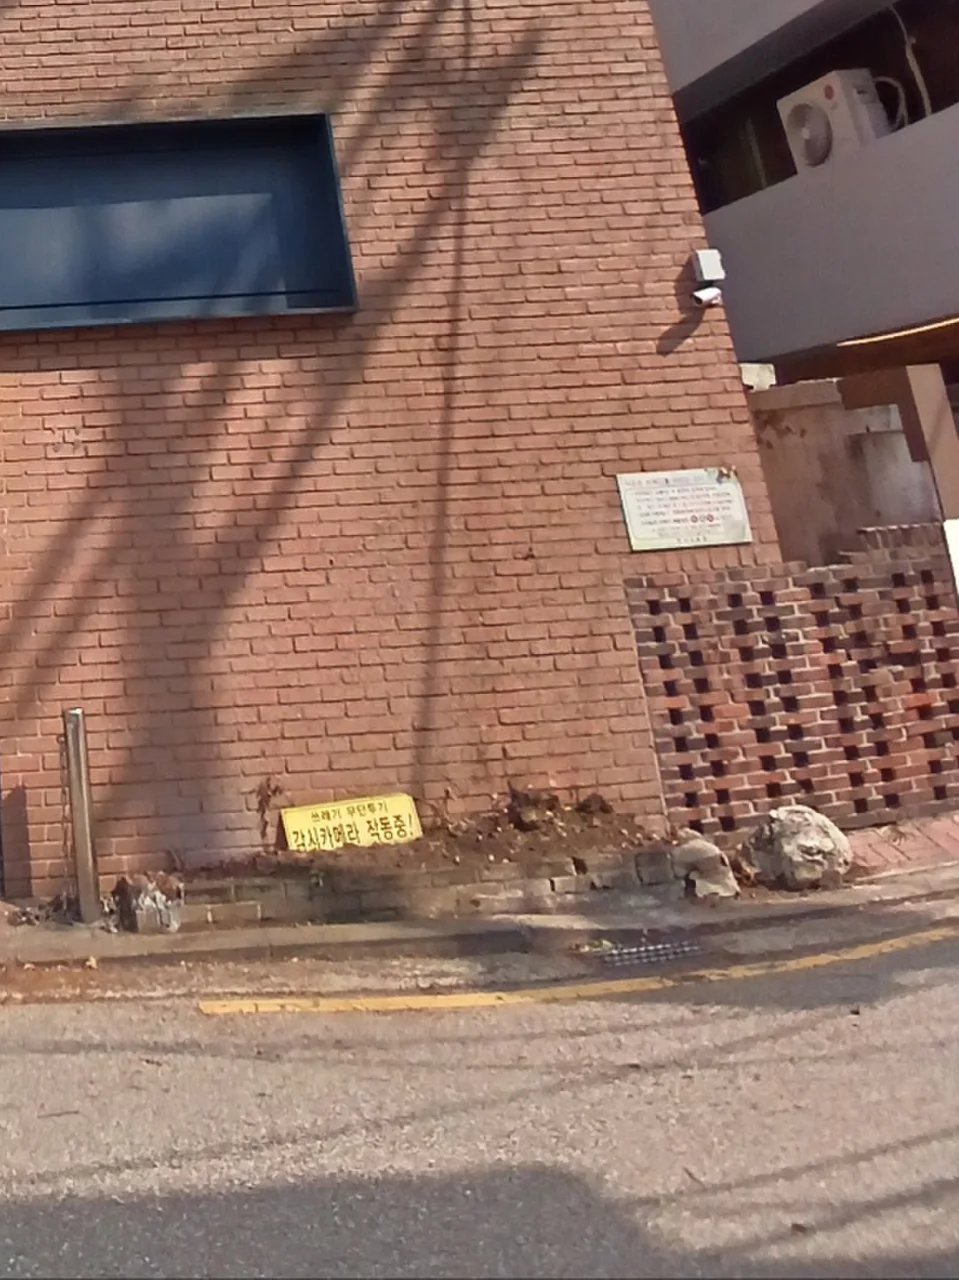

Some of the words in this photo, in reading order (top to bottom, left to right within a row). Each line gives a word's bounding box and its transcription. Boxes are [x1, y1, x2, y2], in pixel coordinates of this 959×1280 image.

[311, 807, 342, 822] 쓰레기
[346, 799, 389, 817] 무단투기
[292, 821, 361, 851] 감시카메라
[366, 813, 414, 841] 작동중!
